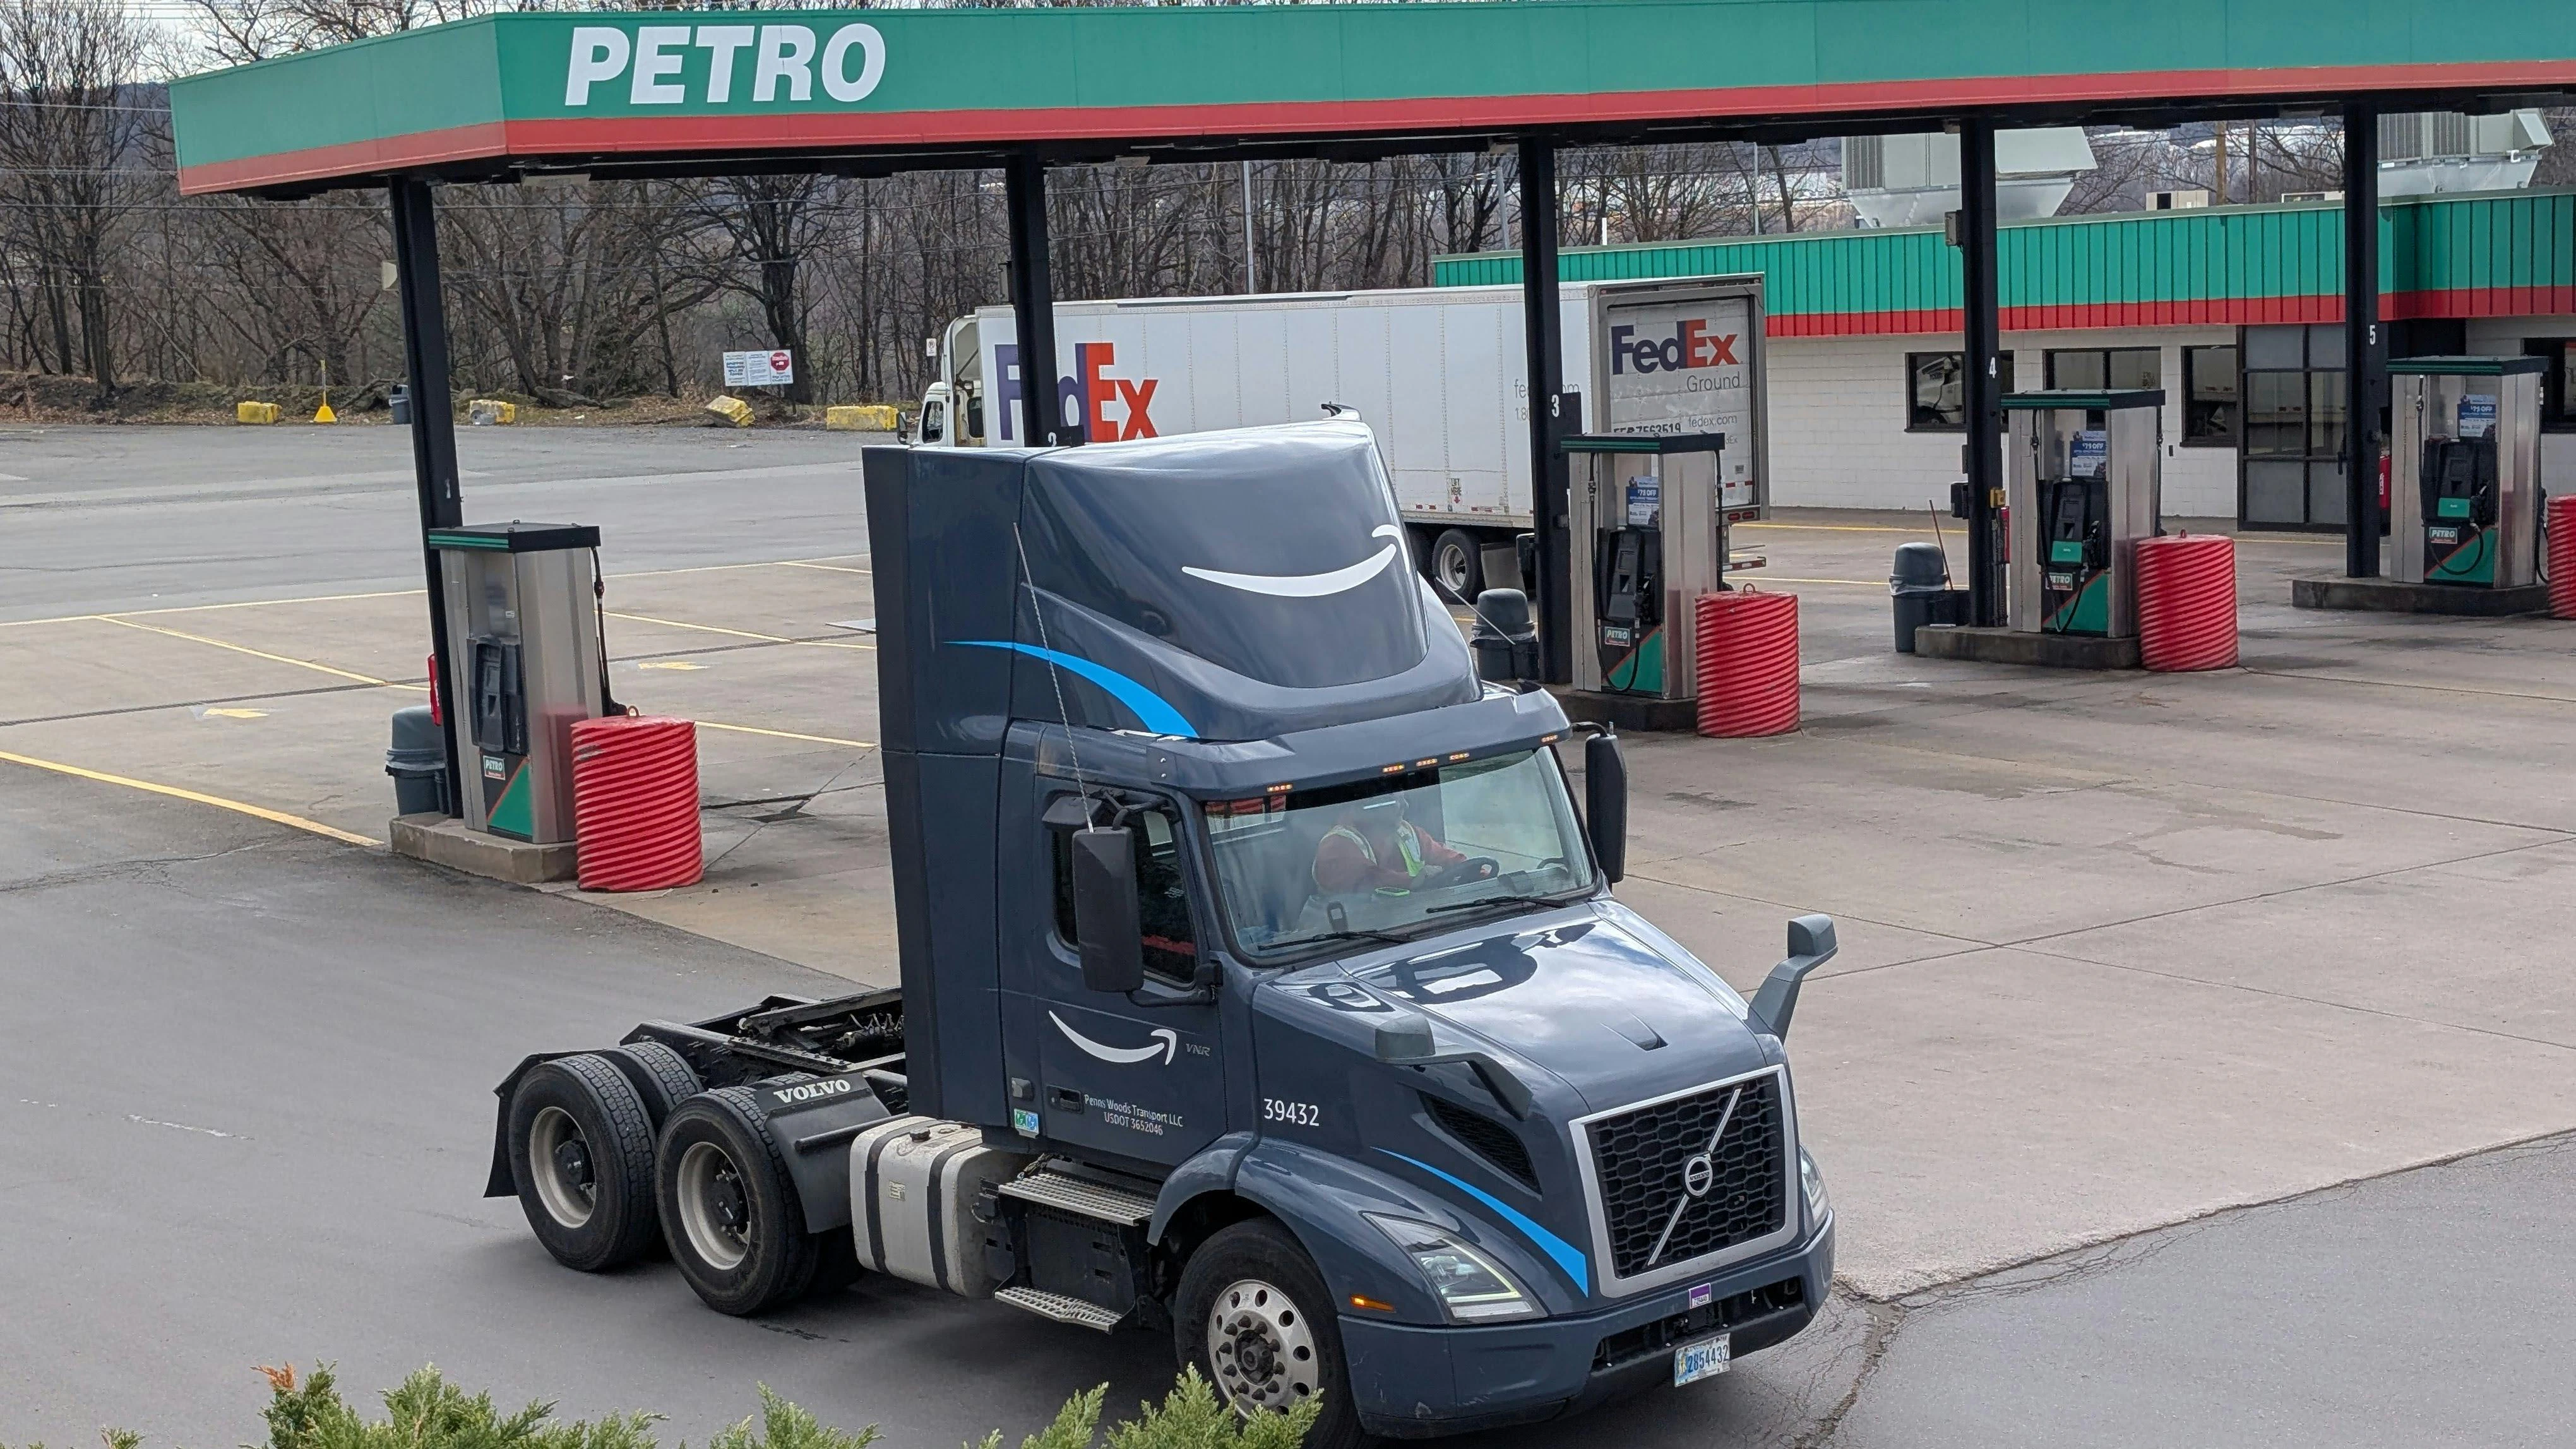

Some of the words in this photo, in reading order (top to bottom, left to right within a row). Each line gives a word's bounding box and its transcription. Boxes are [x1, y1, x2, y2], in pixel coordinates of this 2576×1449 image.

[565, 23, 885, 105] PETRO
[2370, 325, 2375, 345] 5
[1611, 319, 1739, 375] FedEx
[1989, 357, 1997, 378] 4
[994, 342, 1159, 443] FdEx
[1687, 371, 1739, 392] Ground
[1551, 394, 1559, 417] 3
[1689, 415, 1738, 427] fedex.com
[2431, 530, 2455, 538] PETRO
[1607, 629, 1628, 640] PETRO
[486, 759, 503, 772] PETRO
[1186, 1043, 1210, 1057] VNR
[773, 1079, 851, 1103] VOLVO
[1084, 1094, 1106, 1109] Penns
[1106, 1098, 1131, 1115] Woods
[1132, 1104, 1168, 1124] Transport
[1169, 1113, 1184, 1128] LLC
[1264, 1098, 1320, 1126] 39432
[1104, 1111, 1129, 1128] USDOT
[1130, 1118, 1164, 1136] 3652046
[1687, 1344, 1729, 1373] 2854432
